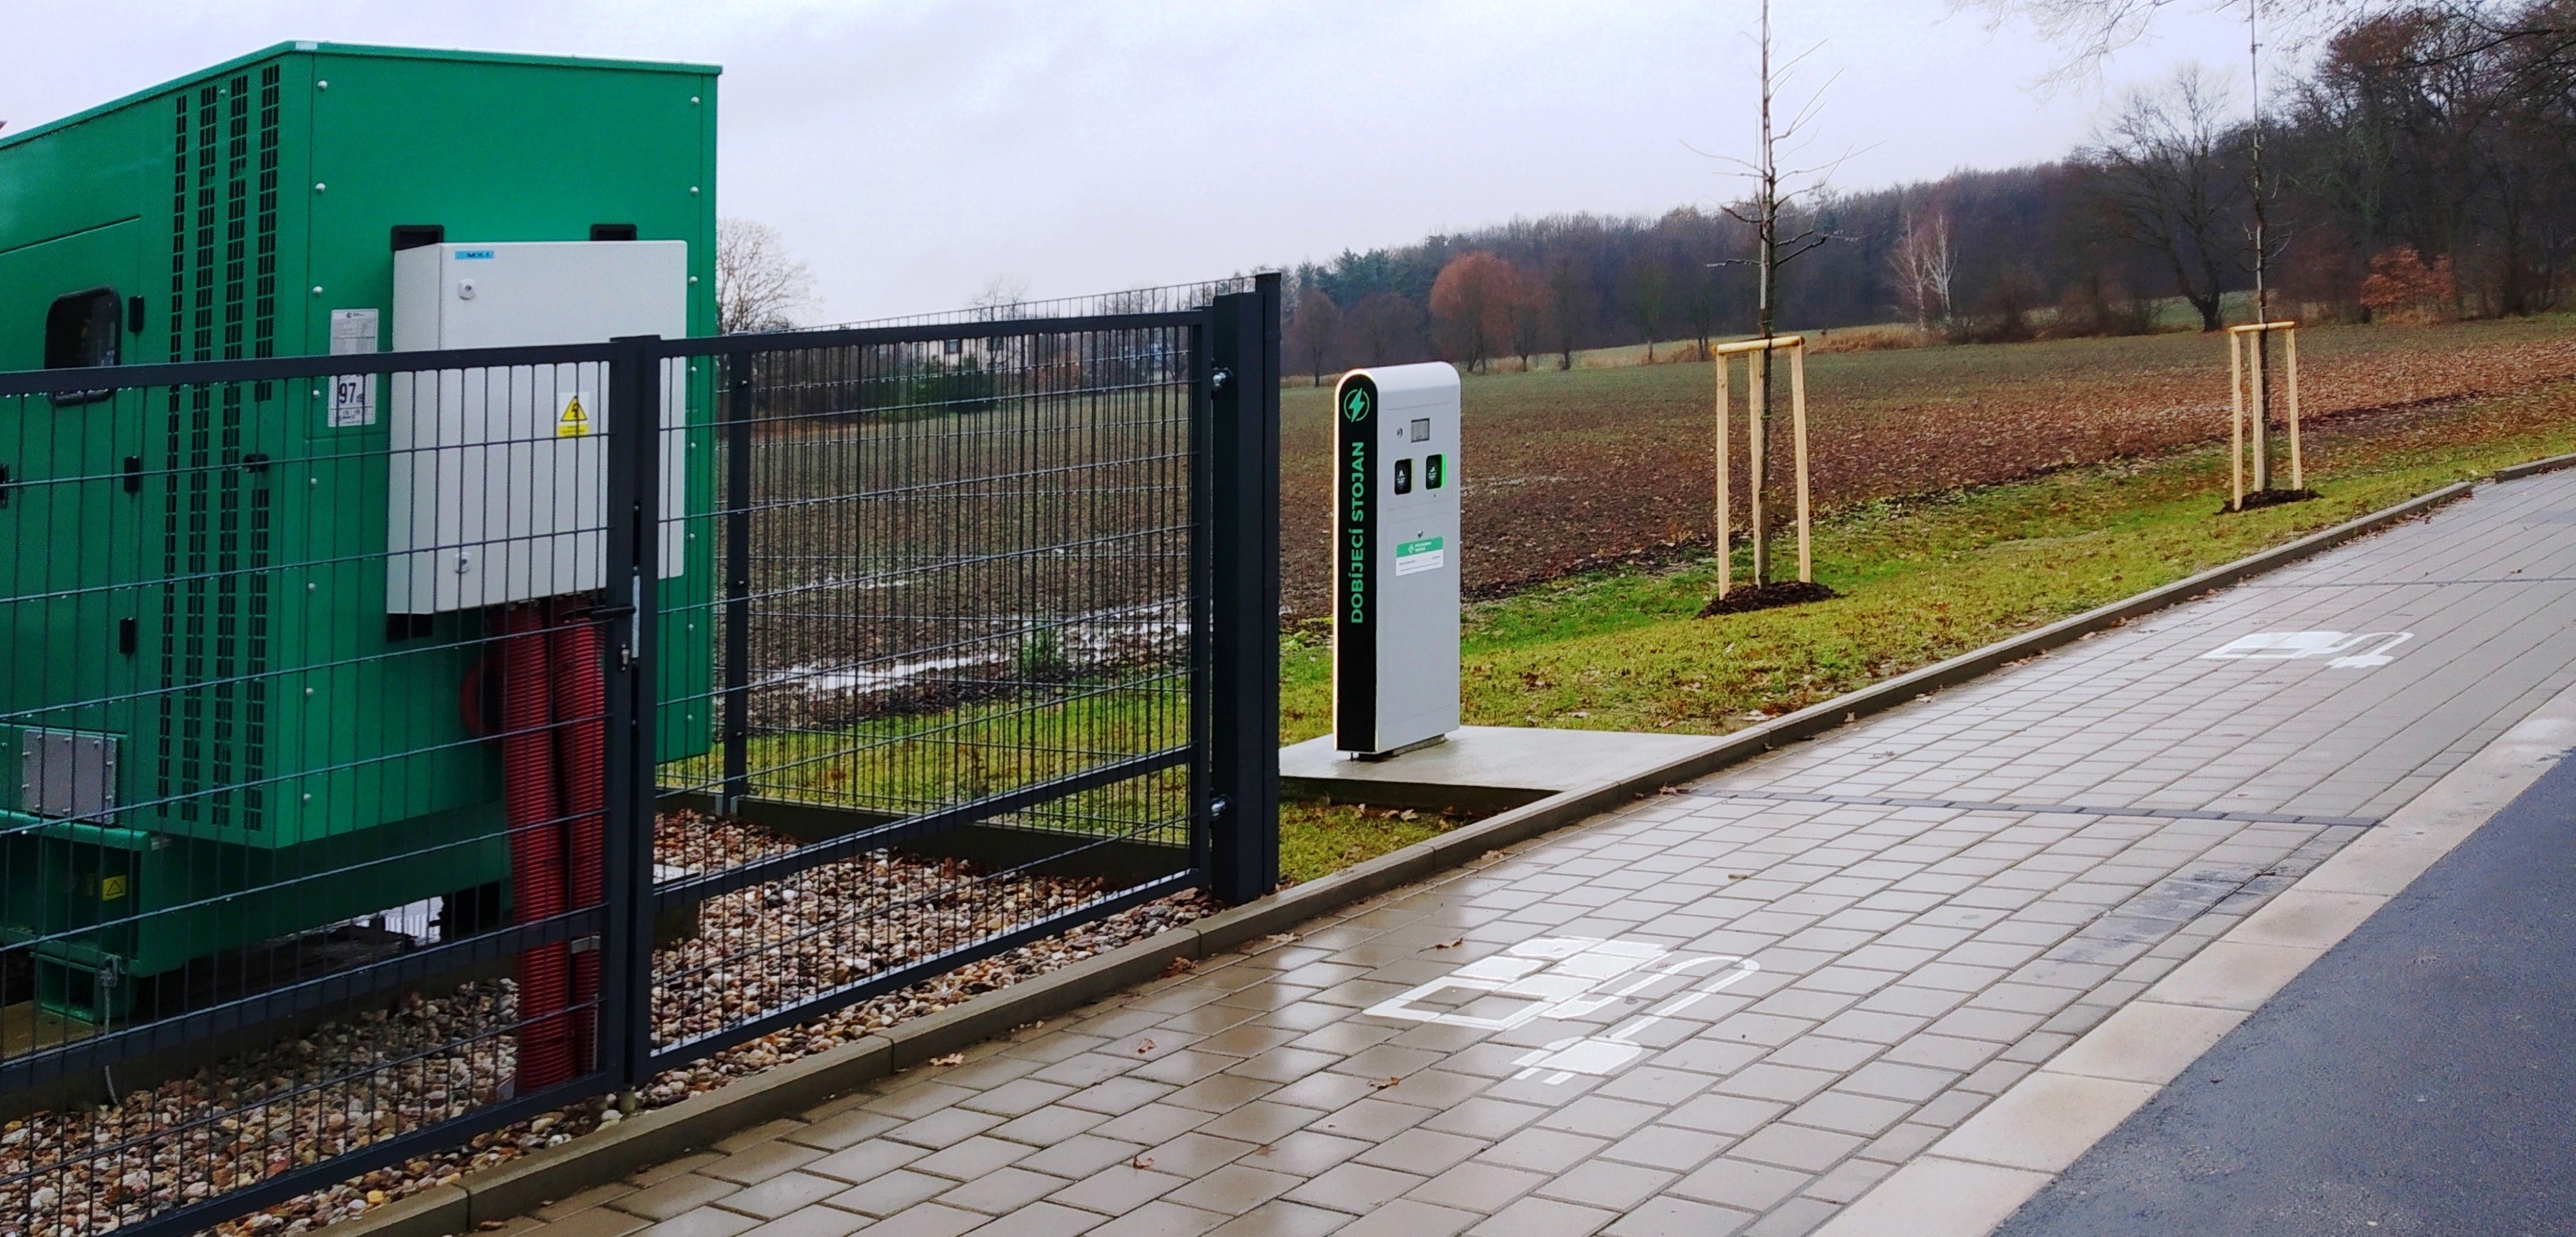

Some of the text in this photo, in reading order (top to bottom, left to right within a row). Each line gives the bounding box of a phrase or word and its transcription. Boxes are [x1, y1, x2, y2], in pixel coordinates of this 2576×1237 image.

[339, 382, 357, 404] 97
[1348, 442, 1365, 624] DOBÍJECÍ STOJAN
